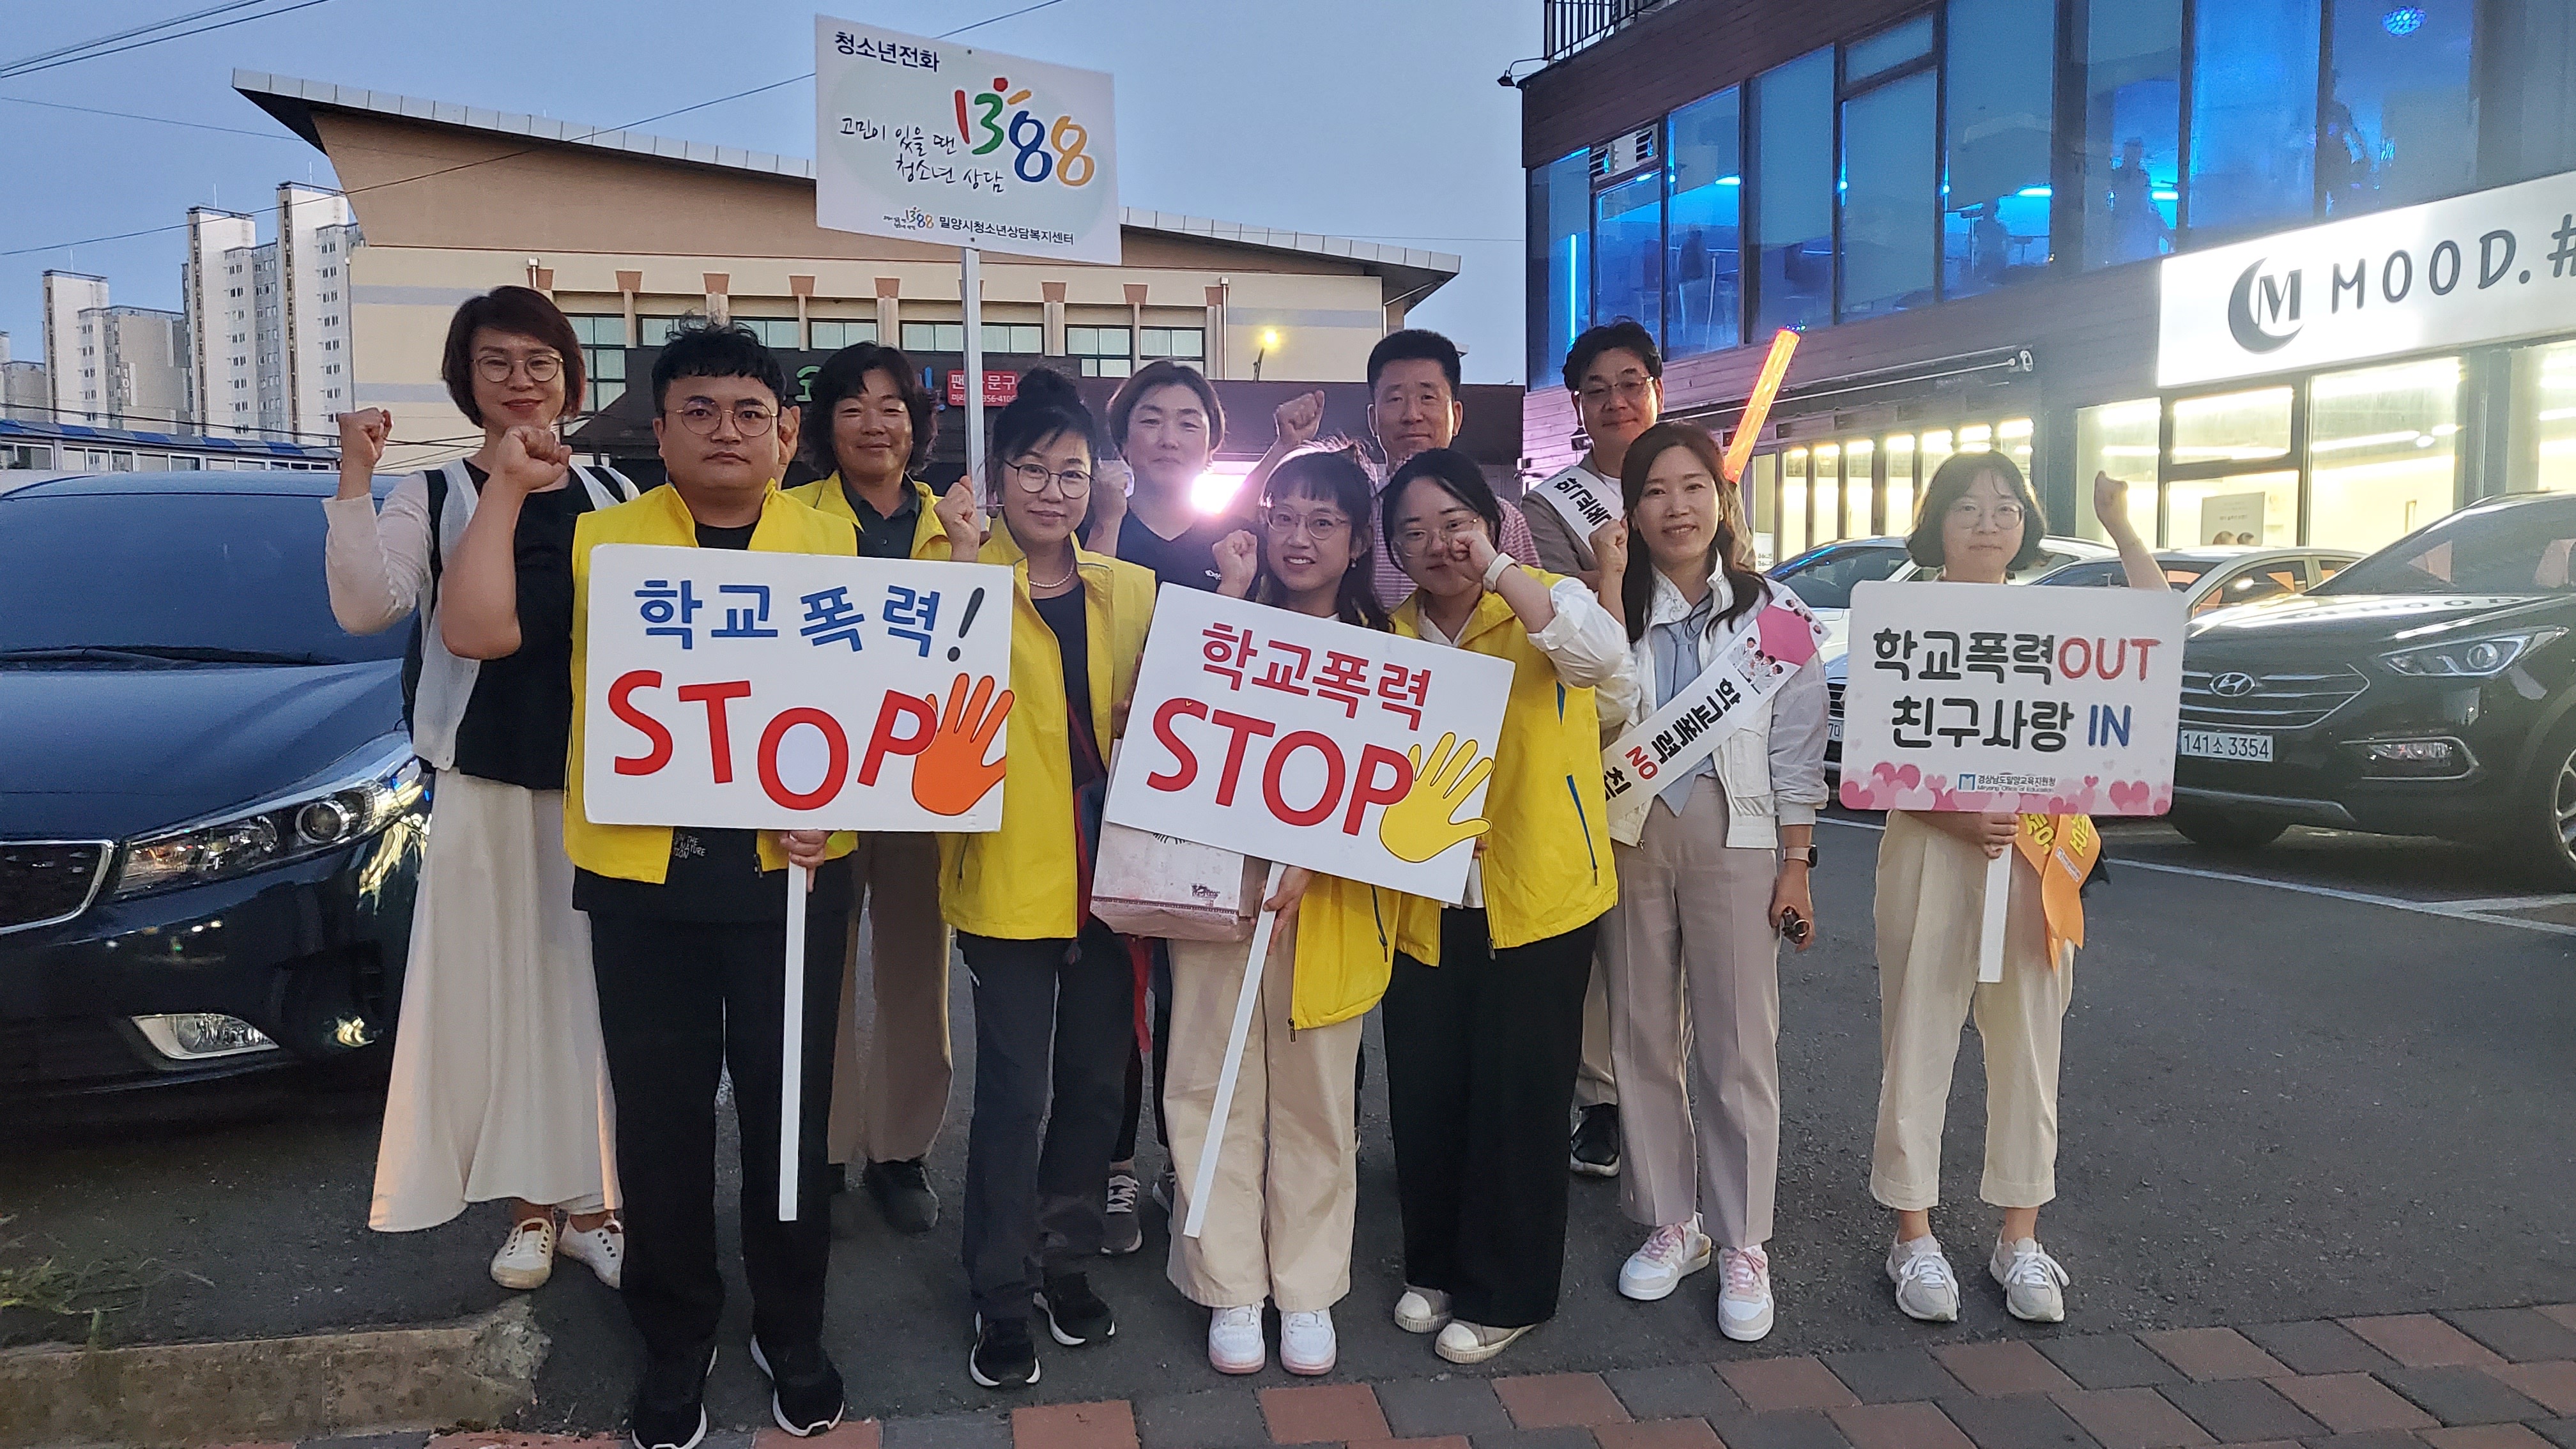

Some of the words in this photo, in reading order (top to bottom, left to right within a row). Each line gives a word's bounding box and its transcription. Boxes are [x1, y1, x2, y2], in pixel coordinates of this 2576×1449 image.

[834, 31, 940, 72] 청소년전화
[839, 117, 886, 142] 고민이
[895, 126, 927, 157] 있을
[933, 133, 956, 155] 땐
[954, 88, 1095, 187] 1388
[895, 157, 956, 185] 청소년
[963, 171, 1004, 194] 상담
[939, 216, 1075, 245] 밀양시청소년상담복지센터
[951, 374, 1016, 391] 팬·문구
[1553, 477, 1613, 526] 학교폭
[634, 579, 985, 662] 학교폭력!
[1202, 622, 1432, 732] 학교폭력
[608, 670, 939, 810] STOP
[1652, 678, 1742, 765] 학교폭력
[1891, 695, 2075, 753] 친구사랑
[2087, 705, 2132, 748] IN
[2184, 732, 2223, 755] 141소
[2228, 736, 2270, 759] 3354
[1146, 697, 1414, 837] STOP
[1625, 746, 1659, 780] NO
